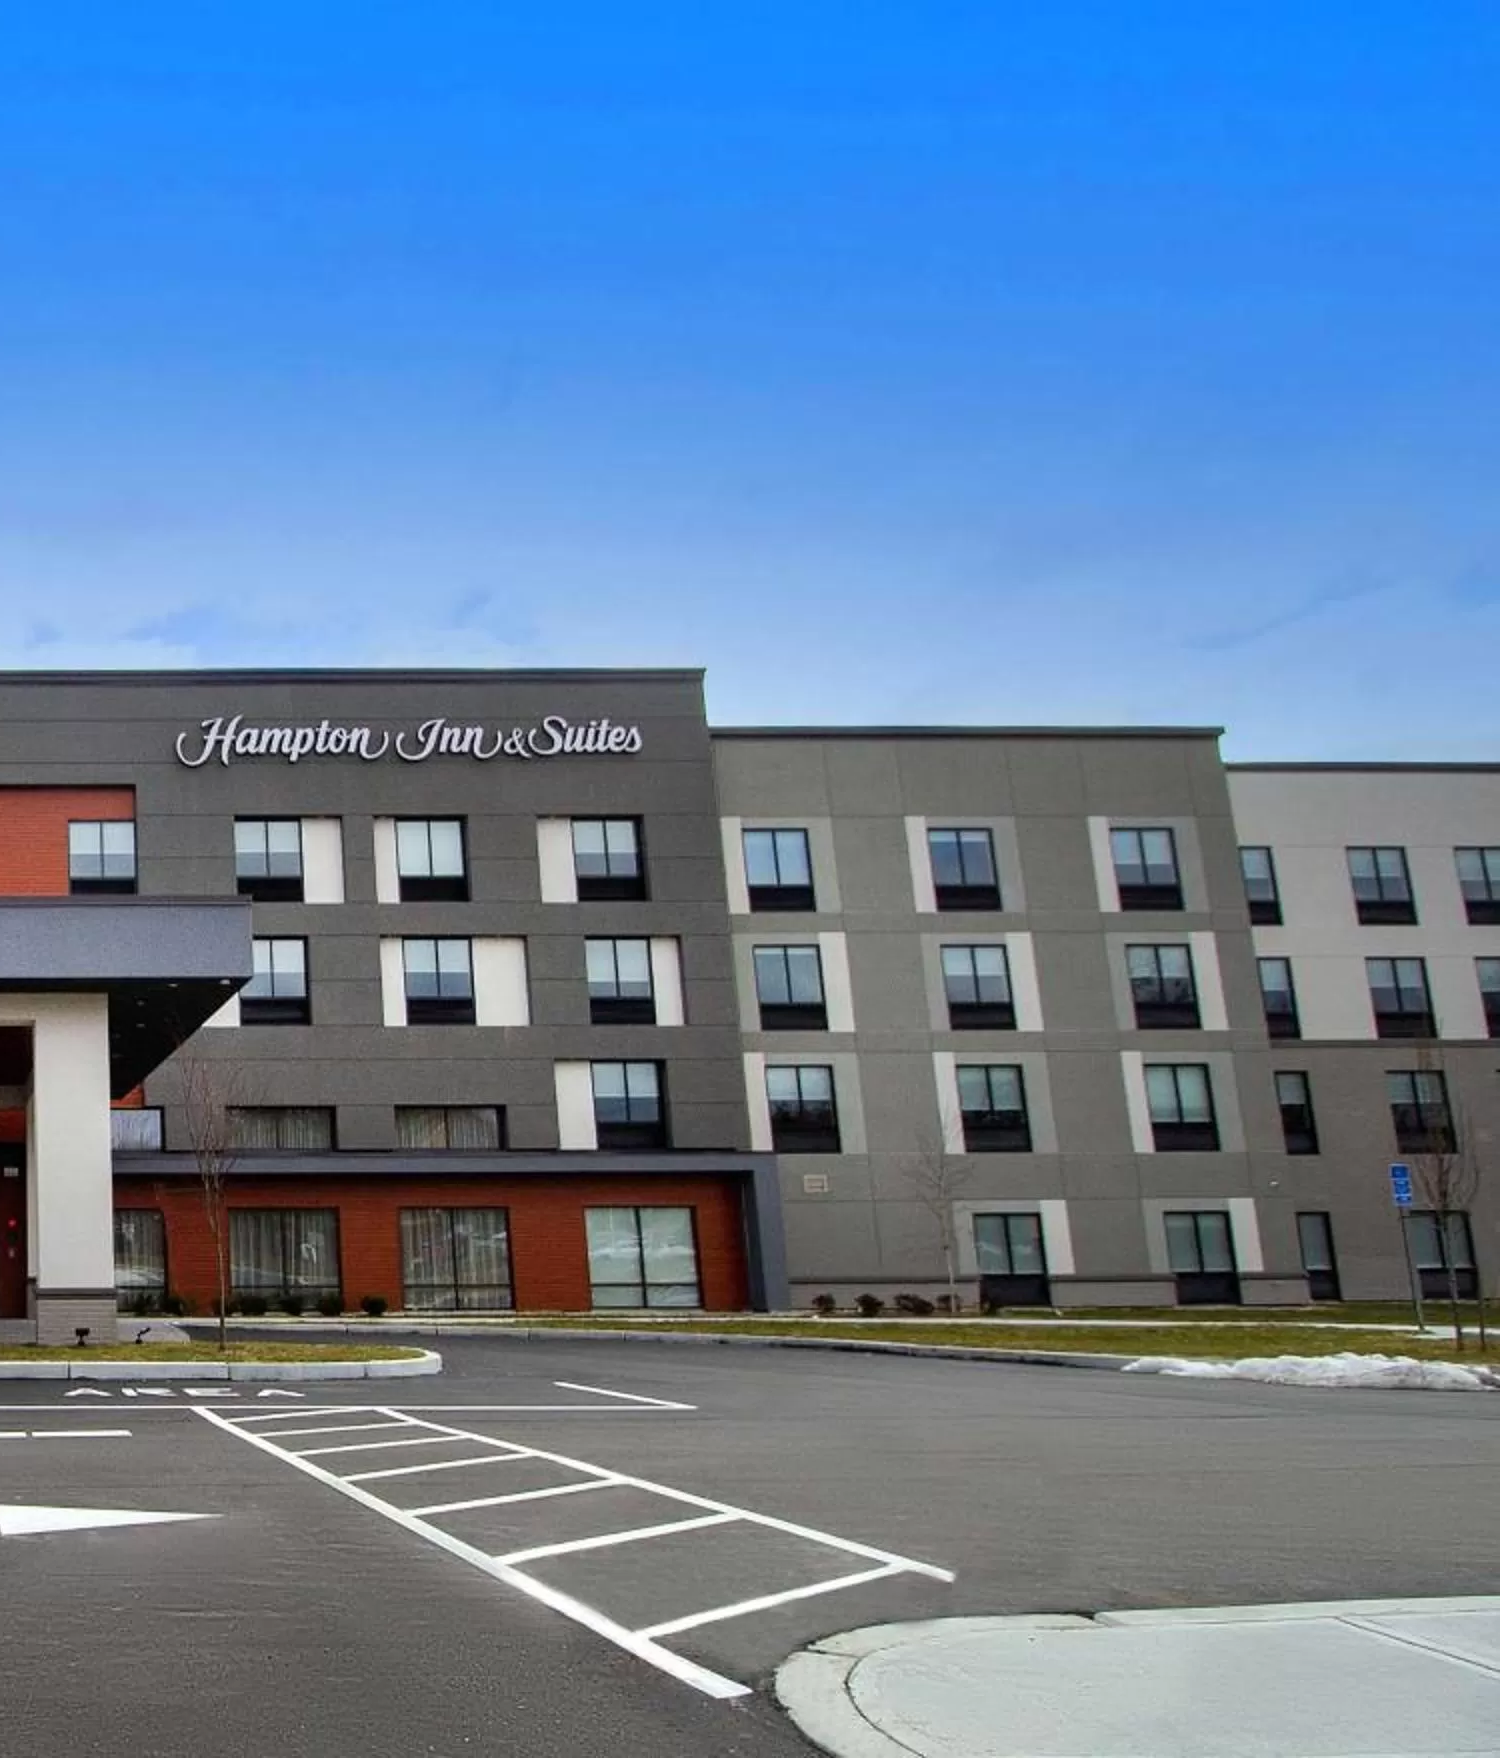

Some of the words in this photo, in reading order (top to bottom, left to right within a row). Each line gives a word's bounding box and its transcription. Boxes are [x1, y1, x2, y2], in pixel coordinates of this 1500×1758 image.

[175, 715, 389, 767] Hampton
[395, 718, 503, 760] Inn
[503, 727, 533, 758] &
[527, 715, 643, 757] Suites
[63, 1387, 307, 1398] AREA
